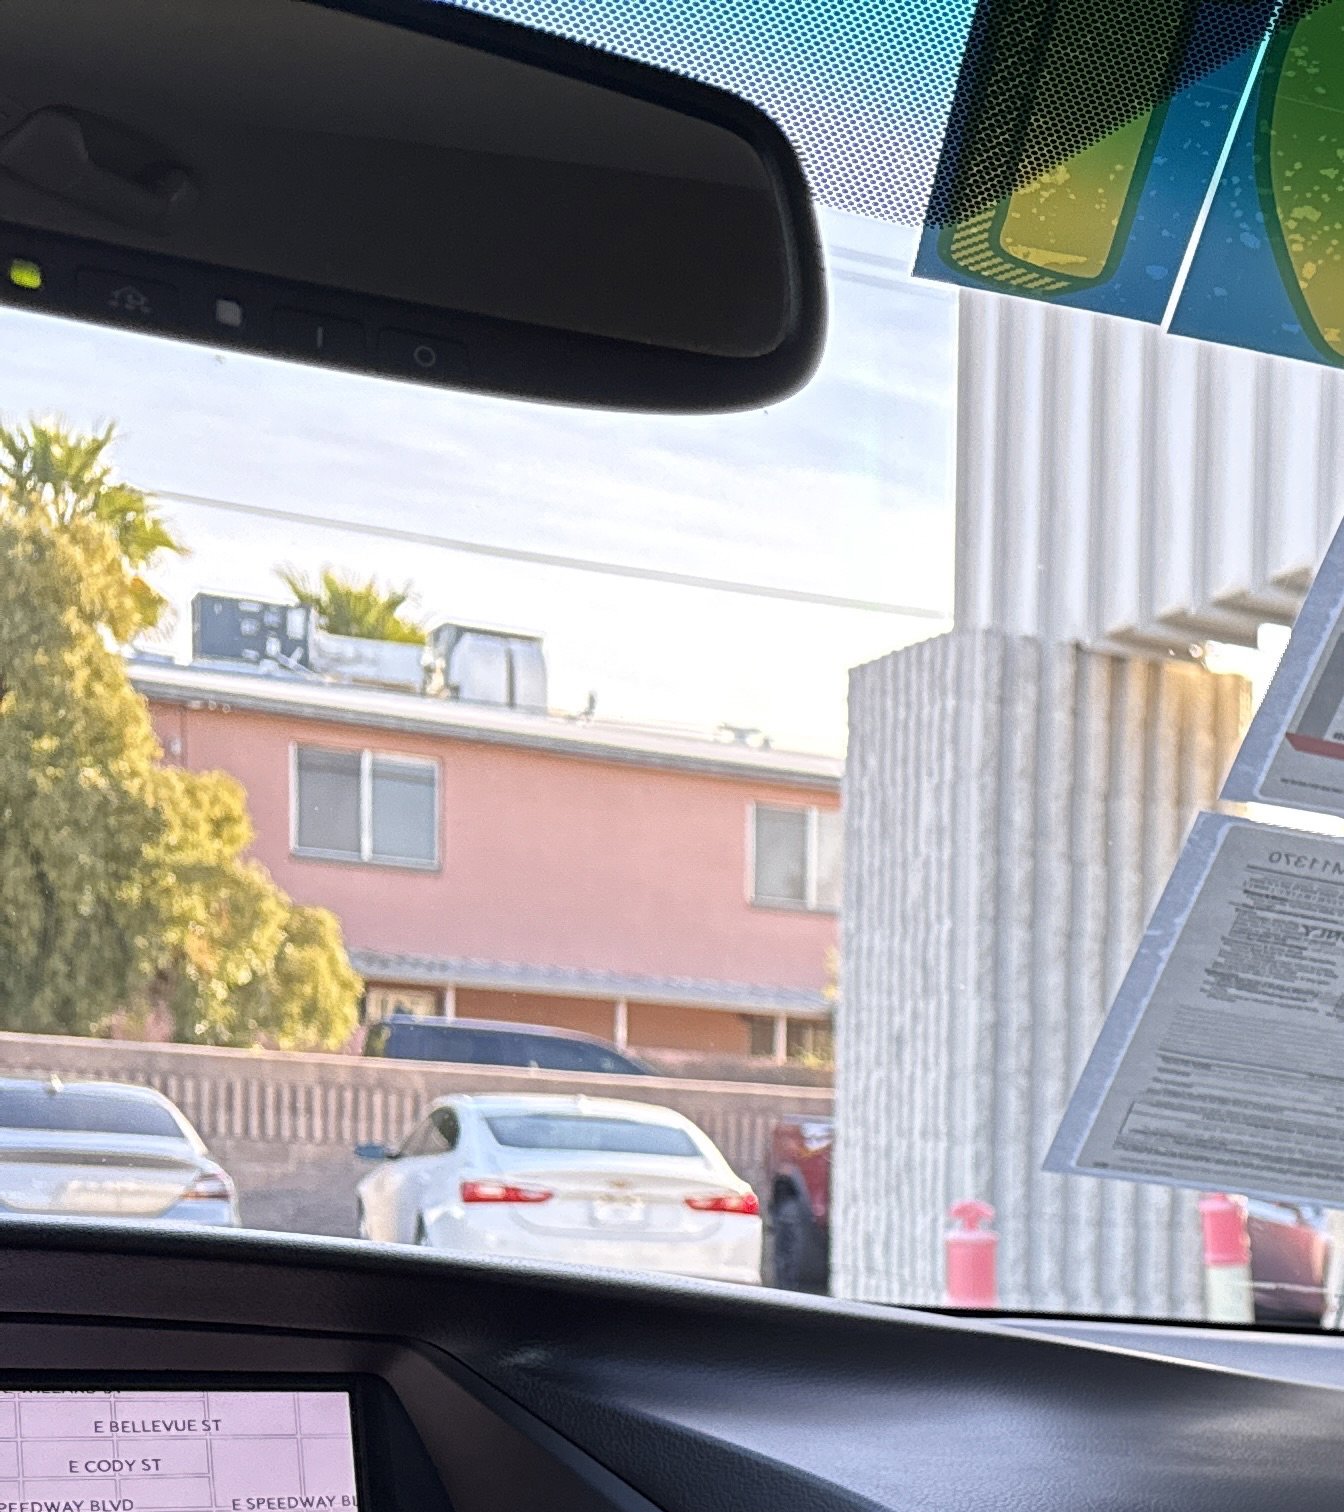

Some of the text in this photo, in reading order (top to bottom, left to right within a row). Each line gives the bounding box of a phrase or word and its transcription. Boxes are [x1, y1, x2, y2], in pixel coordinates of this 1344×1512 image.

[94, 1418, 222, 1433] E BELLEVUE ST
[69, 1458, 162, 1473] E CODY ST
[90, 1498, 134, 1512] BLVD
[232, 1498, 241, 1511] E
[247, 1495, 336, 1510] SPEEDWAY
